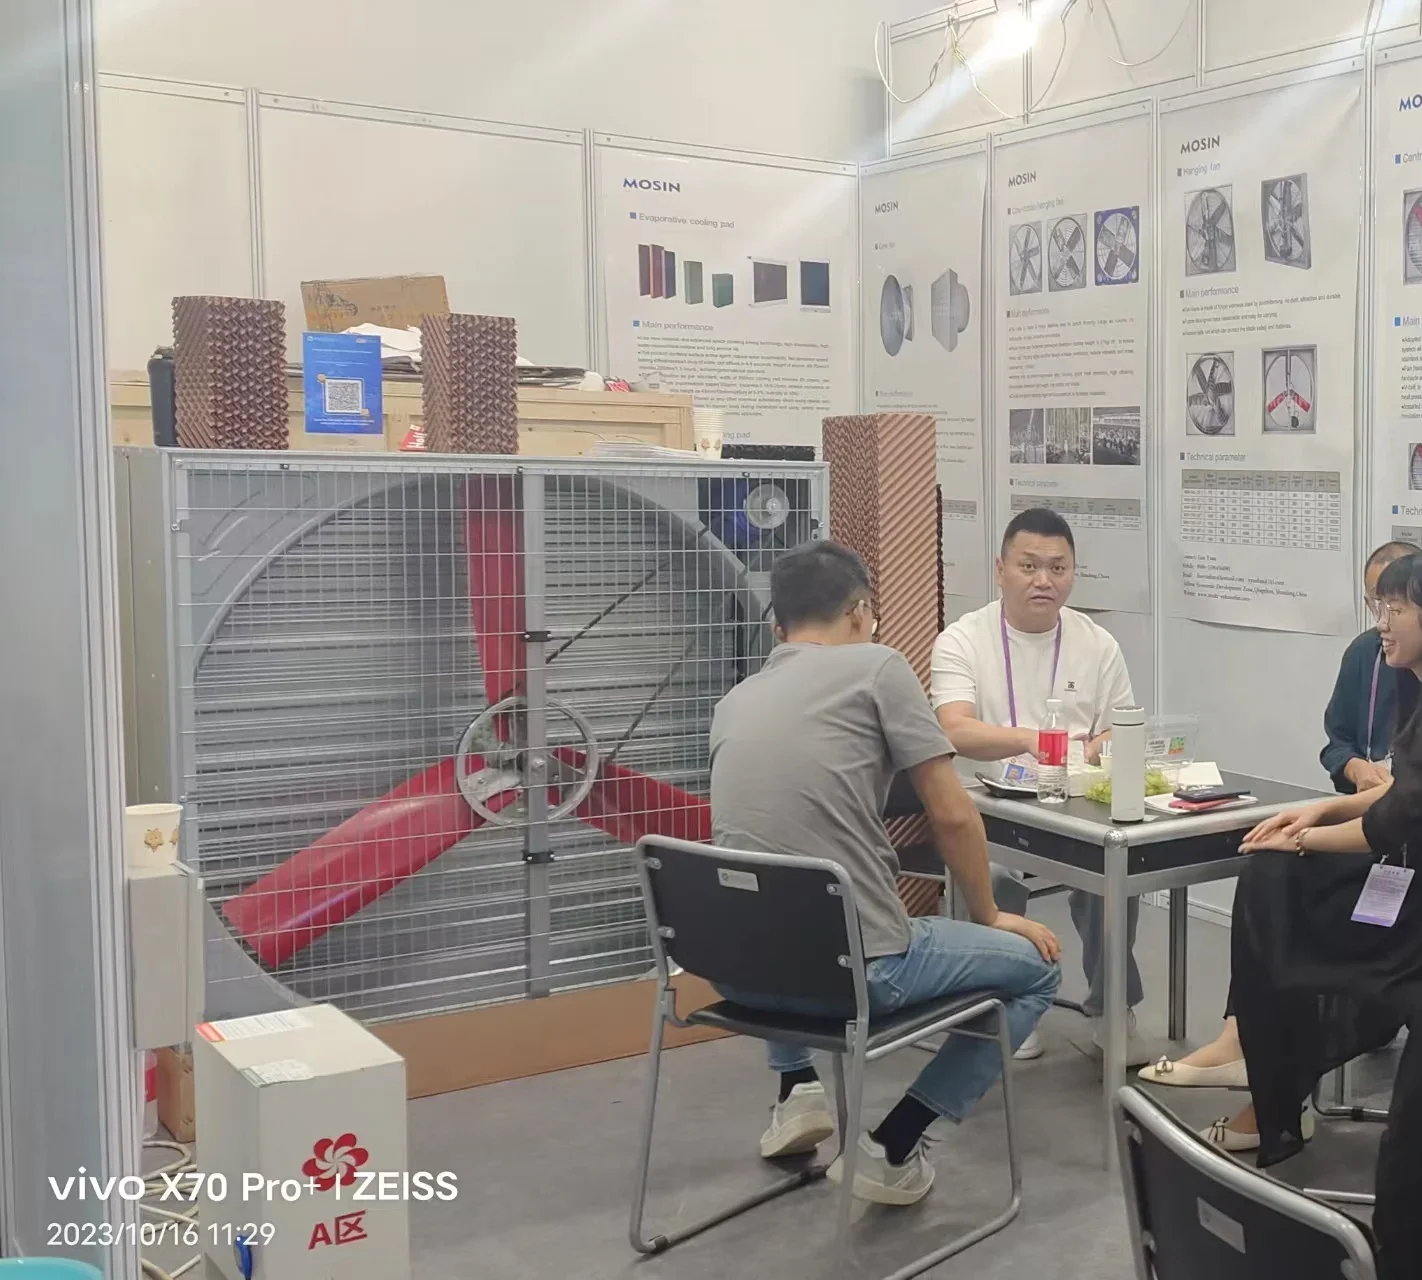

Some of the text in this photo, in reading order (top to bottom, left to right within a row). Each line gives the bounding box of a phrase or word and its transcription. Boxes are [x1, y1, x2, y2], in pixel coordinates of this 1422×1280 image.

[1180, 136, 1220, 154] MOSIN
[623, 178, 680, 192] MOSIN
[1008, 170, 1036, 188] MOSIN
[875, 200, 898, 214] MOSIN
[639, 214, 734, 229] Evaporative cooling pad
[1185, 286, 1239, 298] Main performance
[642, 320, 714, 332] Main performance
[1403, 316, 1420, 327] Main
